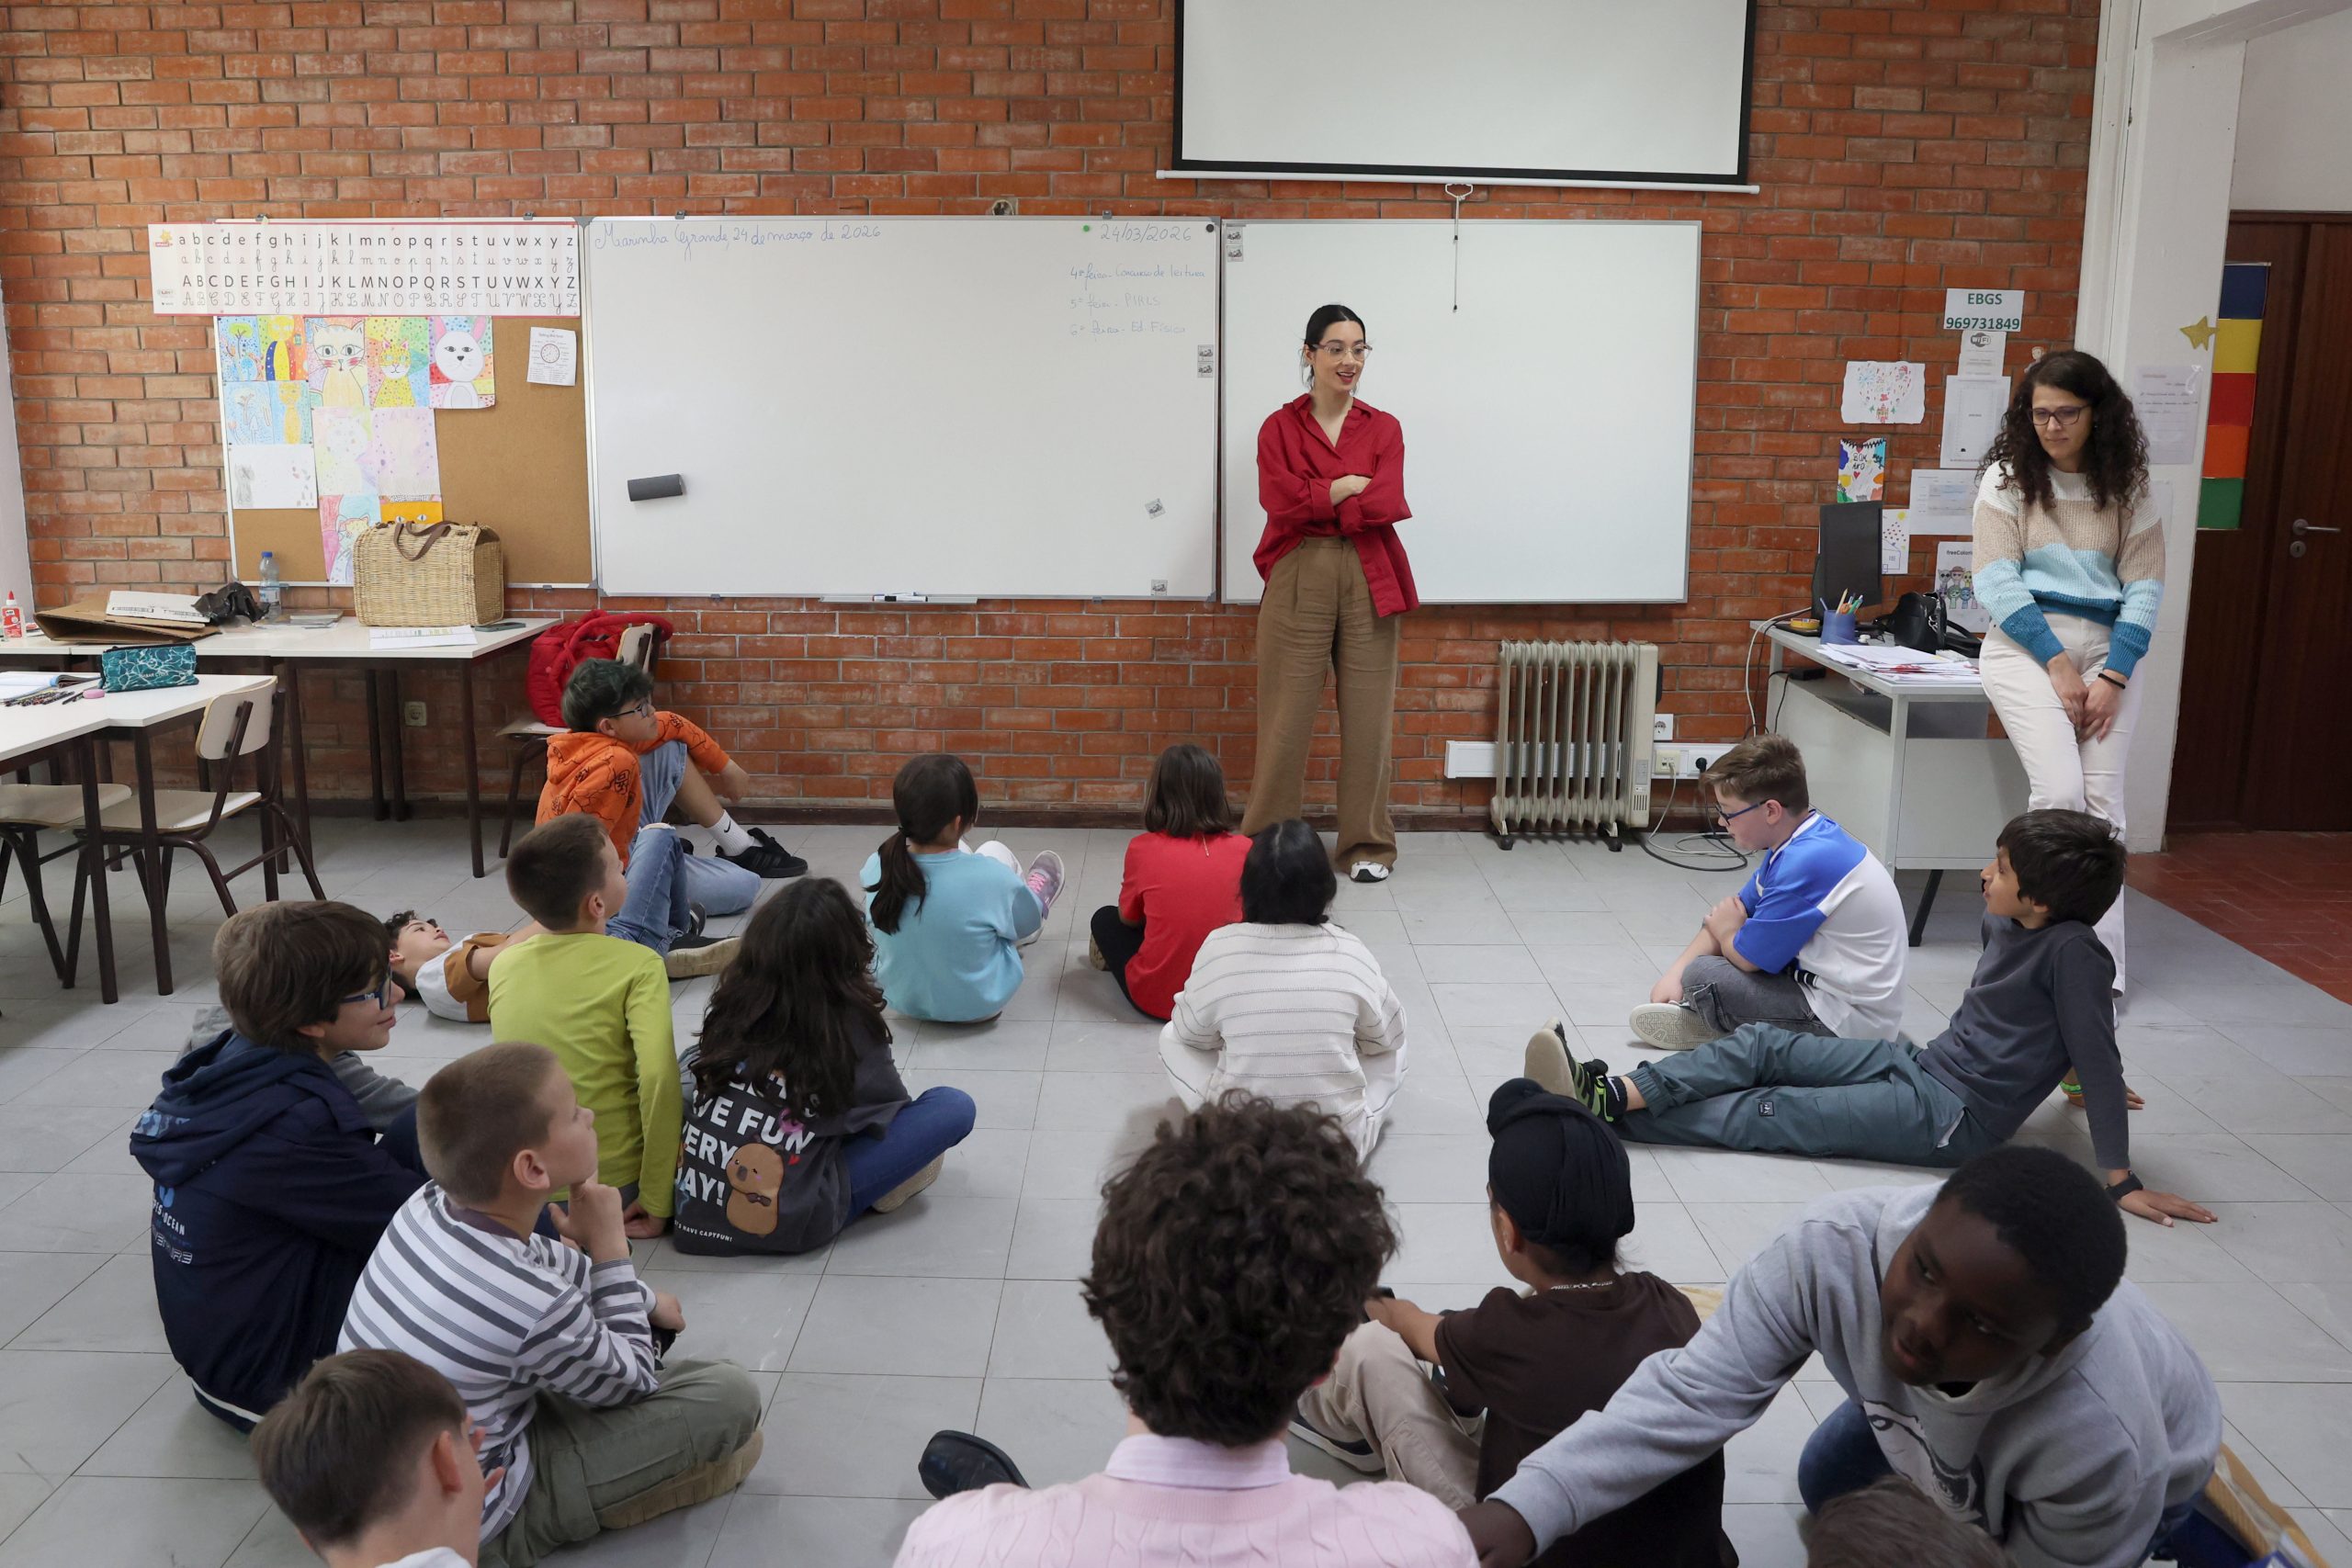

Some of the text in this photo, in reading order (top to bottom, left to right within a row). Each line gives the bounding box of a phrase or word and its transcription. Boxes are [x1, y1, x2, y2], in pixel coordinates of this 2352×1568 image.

[193, 233, 200, 245] b
[223, 233, 230, 245] d
[239, 237, 245, 245] e
[255, 233, 261, 245] f
[269, 237, 277, 248] g
[285, 233, 292, 245] h
[331, 233, 338, 246] k
[360, 237, 371, 246] m
[378, 237, 385, 246] n
[393, 238, 401, 246] o
[409, 237, 416, 249] p
[424, 238, 432, 249] q
[457, 237, 463, 246] s
[472, 236, 478, 246] t
[488, 237, 494, 246] u
[504, 238, 510, 246] v
[516, 237, 528, 246] w
[535, 237, 541, 246] x
[550, 237, 557, 249] y
[567, 238, 573, 246] z
[595, 222, 669, 250] Marinha
[732, 227, 748, 242] 24
[750, 224, 766, 246] de
[820, 220, 835, 241] de
[841, 223, 882, 240] 2026
[1101, 222, 1191, 243] 24/03/2026
[195, 250, 201, 264] b
[223, 251, 231, 264] d
[256, 250, 262, 272] f
[271, 257, 278, 272] g
[286, 250, 293, 264] h
[331, 250, 340, 264] k
[408, 257, 418, 273] p
[425, 258, 431, 273] q
[441, 256, 448, 265] r
[457, 256, 464, 265] s
[472, 252, 477, 265] t
[551, 258, 558, 273] y
[566, 257, 574, 273] z
[183, 275, 575, 290] A B C D E F G H I J K L M N O P Q R S T U V W X Y Z
[183, 292, 193, 306] A
[197, 292, 205, 306] B
[209, 292, 218, 306] C
[224, 292, 235, 306] D
[241, 292, 250, 306] E
[255, 292, 265, 306] F
[271, 292, 281, 313] G
[285, 292, 295, 306] H
[317, 292, 325, 313] J
[331, 293, 343, 307] K
[346, 293, 358, 307] L
[361, 293, 374, 307] M
[378, 293, 389, 307] N
[394, 293, 404, 307] O
[409, 293, 420, 307] P
[424, 293, 437, 307] Q
[440, 293, 452, 307] R
[456, 293, 467, 307] S
[471, 293, 482, 307] T
[486, 293, 500, 308] U
[502, 293, 515, 307] V
[516, 293, 531, 307] W
[533, 293, 546, 307] X
[550, 293, 563, 314] Y
[566, 293, 577, 307] Z
[1968, 293, 2002, 305] EBGS
[1946, 317, 2020, 330] 969731849
[737, 1107, 815, 1154] FUN
[683, 1121, 738, 1170] ERY
[163, 1212, 185, 1235] OCEAN
[683, 1225, 698, 1235] HAVE
